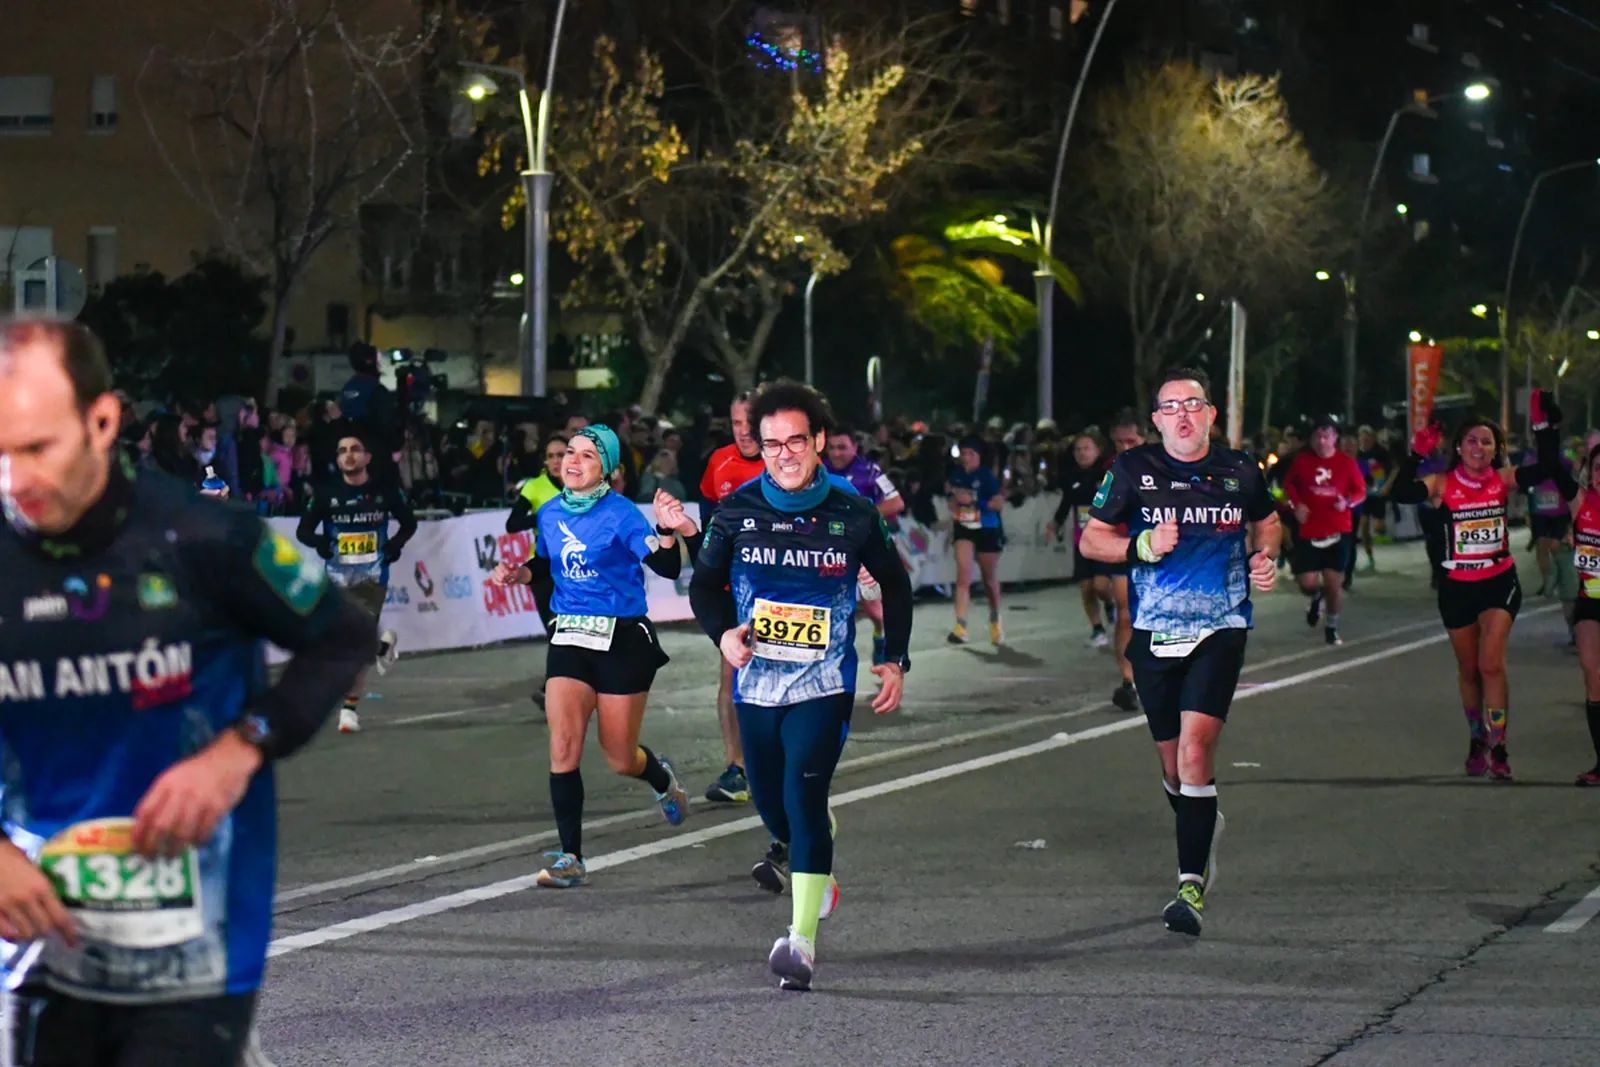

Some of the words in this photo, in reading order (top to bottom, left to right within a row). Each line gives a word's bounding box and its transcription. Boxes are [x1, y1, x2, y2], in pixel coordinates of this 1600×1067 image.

[1141, 507, 1176, 523] SAN
[1182, 503, 1242, 524] ANTÓN
[1460, 528, 1499, 541] 9631
[741, 547, 776, 565] SAN
[782, 547, 846, 568] ANTÓN
[1578, 555, 1600, 568] 95
[560, 614, 608, 632] 2339
[757, 617, 822, 643] 3976
[0, 661, 45, 700] AN
[56, 637, 192, 698] ANTÓN
[52, 853, 185, 899] 1328
